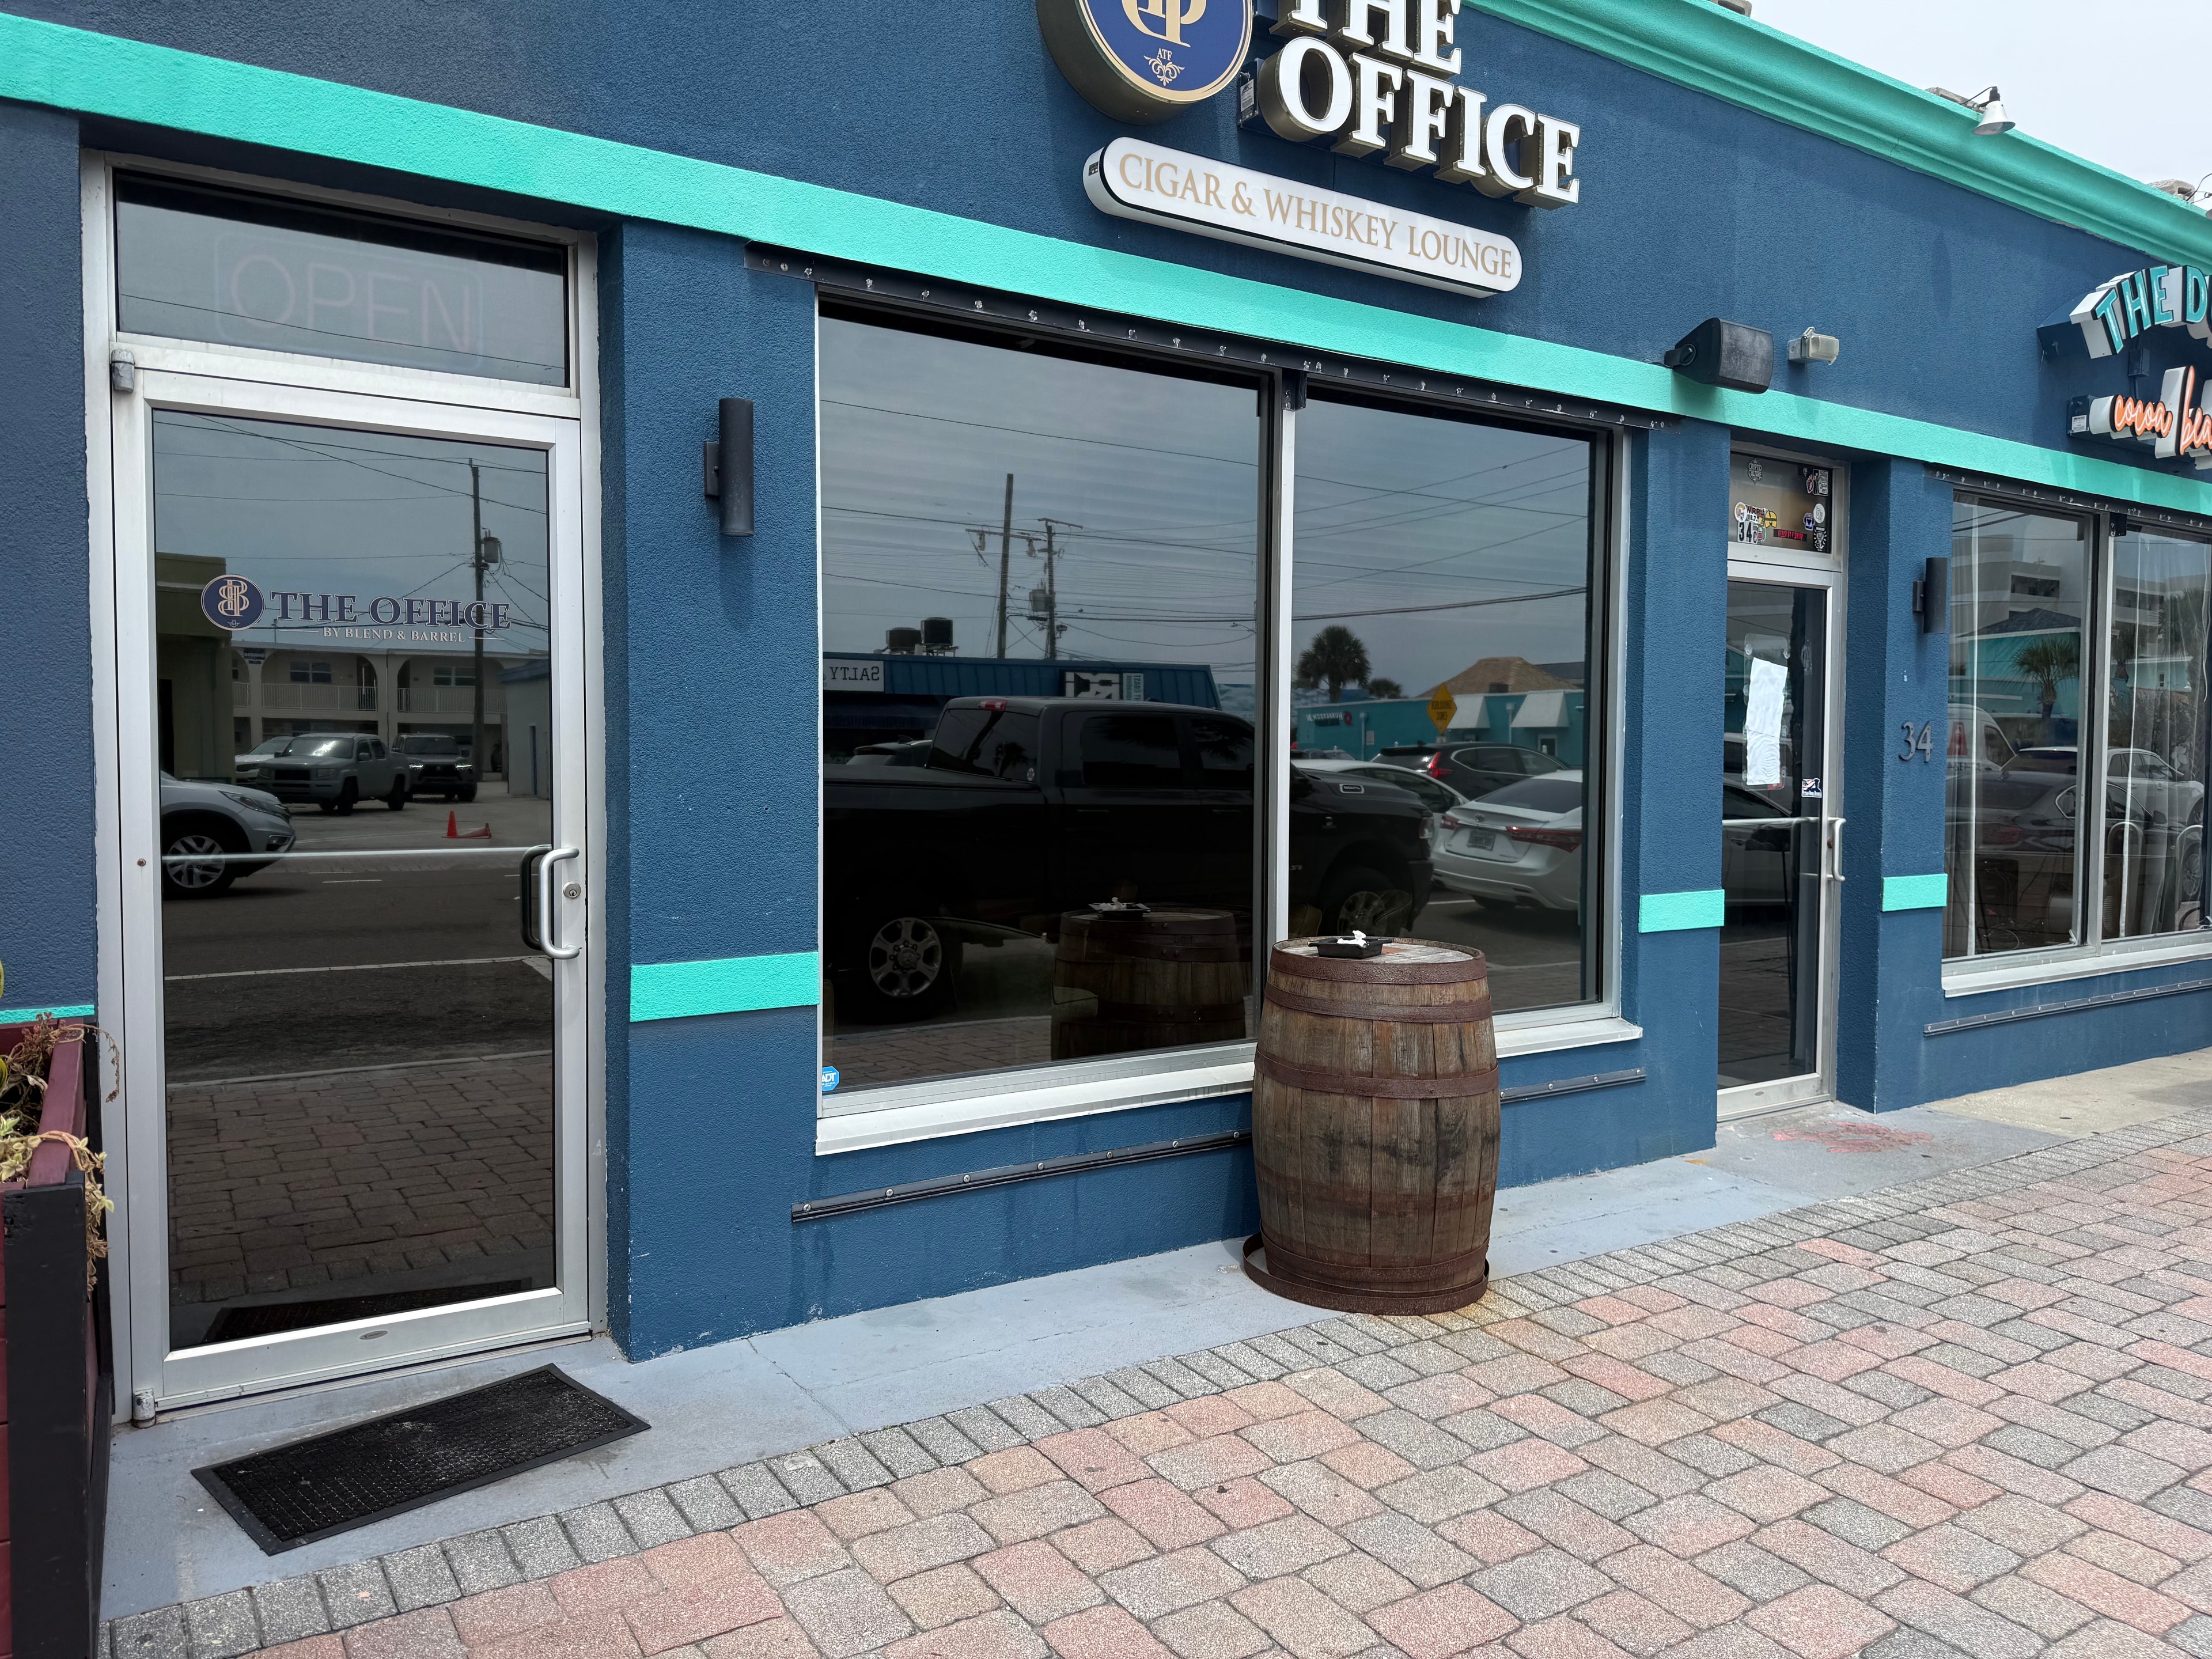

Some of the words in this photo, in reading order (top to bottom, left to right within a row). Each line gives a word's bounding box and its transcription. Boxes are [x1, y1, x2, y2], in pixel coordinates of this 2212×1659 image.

[1157, 47, 1173, 61] ATF
[1278, 36, 1580, 205] OFFICE
[1119, 153, 1227, 210] CIGAR
[1232, 181, 1256, 215] &
[1264, 188, 1398, 250] WHISKEY
[1408, 225, 1513, 279] LOUNGE
[231, 253, 470, 354] OPEN
[2095, 265, 2174, 354] THE
[2186, 265, 2212, 324] D
[2115, 394, 2173, 438] cocoa
[270, 591, 358, 623] THE
[369, 596, 512, 630] OFFICE
[323, 627, 342, 638] BY
[346, 627, 392, 639] BLEND
[397, 631, 406, 640] &
[411, 631, 465, 642] BARREL
[1899, 721, 1933, 763] 34
[822, 1073, 836, 1082] ADT
